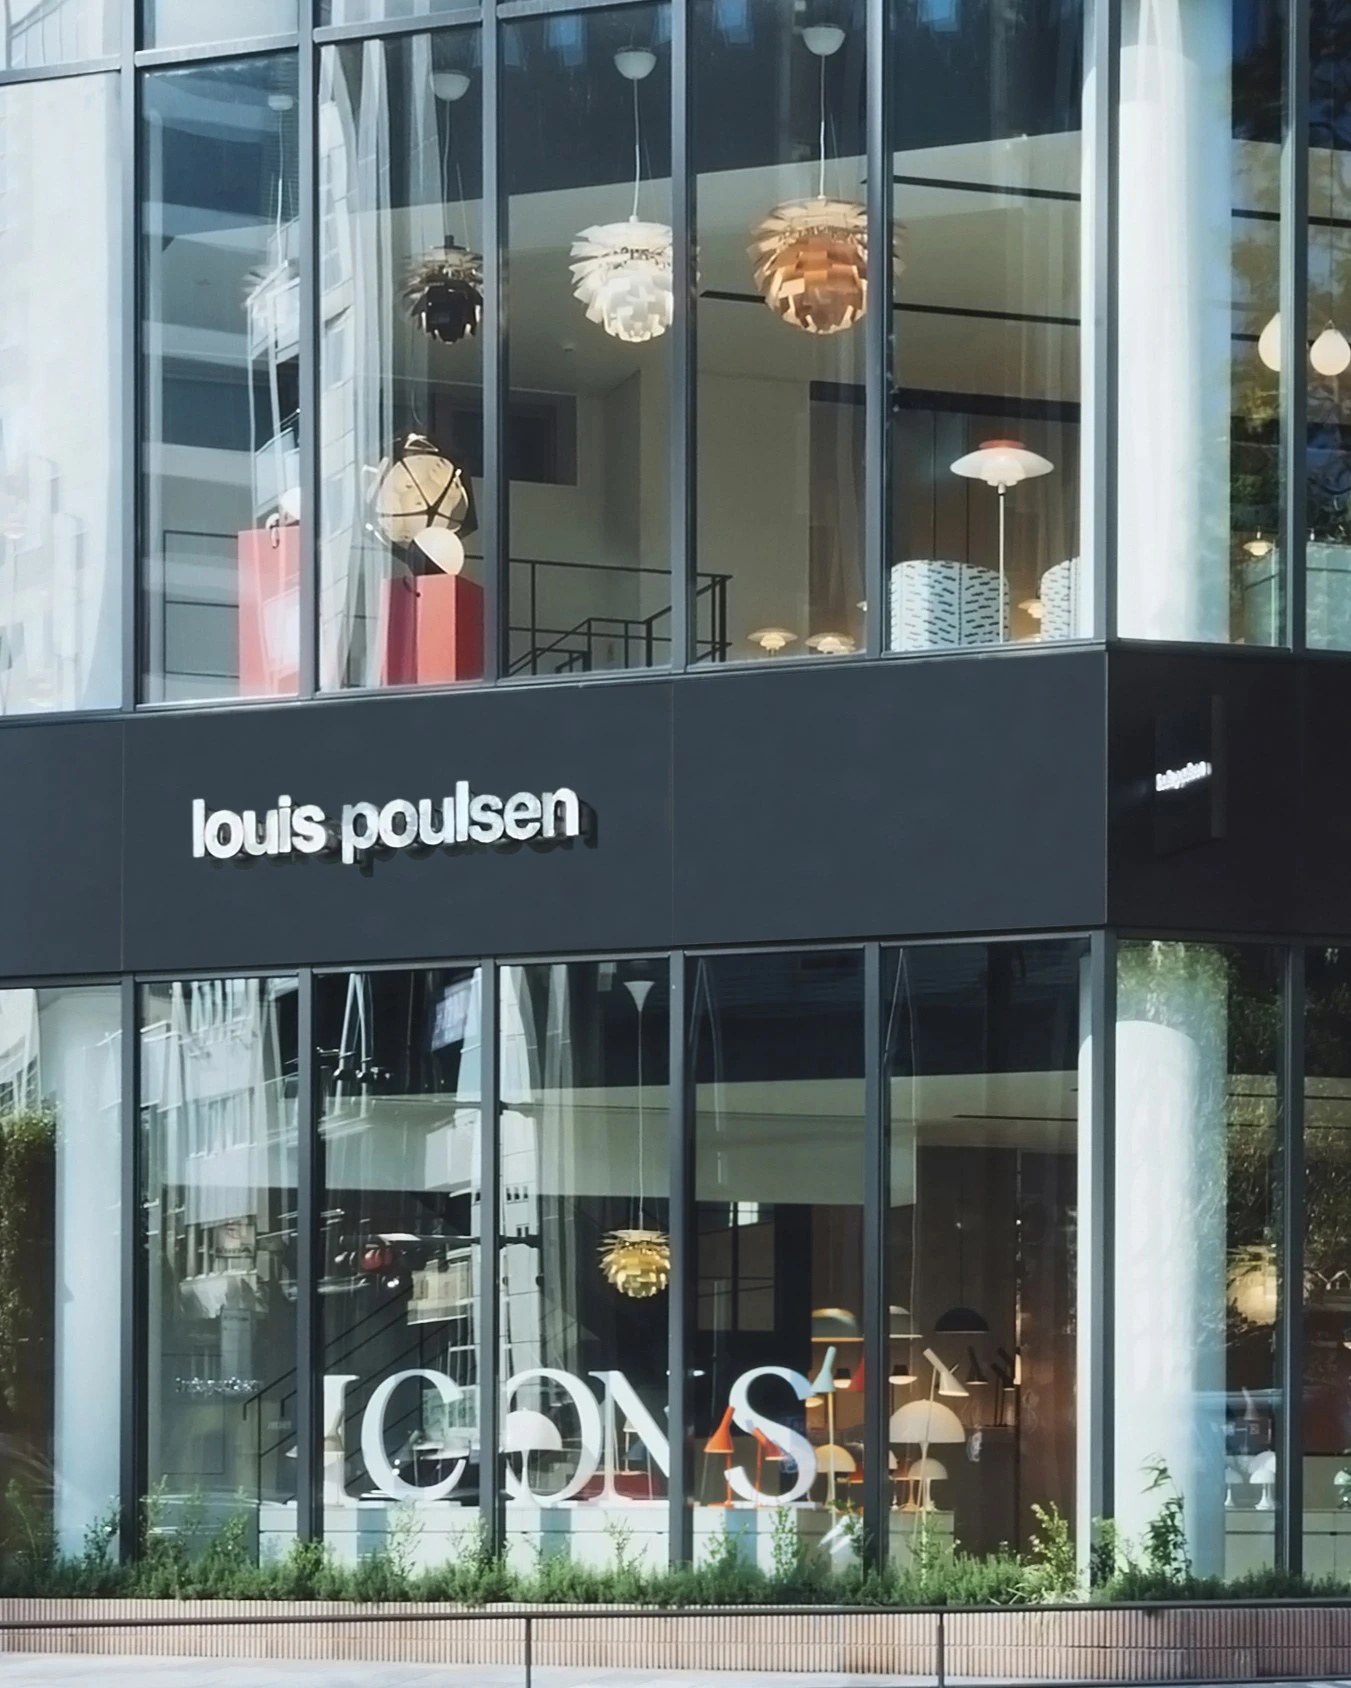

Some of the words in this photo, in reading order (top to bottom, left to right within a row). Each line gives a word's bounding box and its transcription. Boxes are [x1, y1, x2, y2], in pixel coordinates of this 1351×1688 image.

[192, 795, 326, 858] louis
[342, 780, 579, 864] poulsen
[323, 1366, 818, 1504] ICONS
